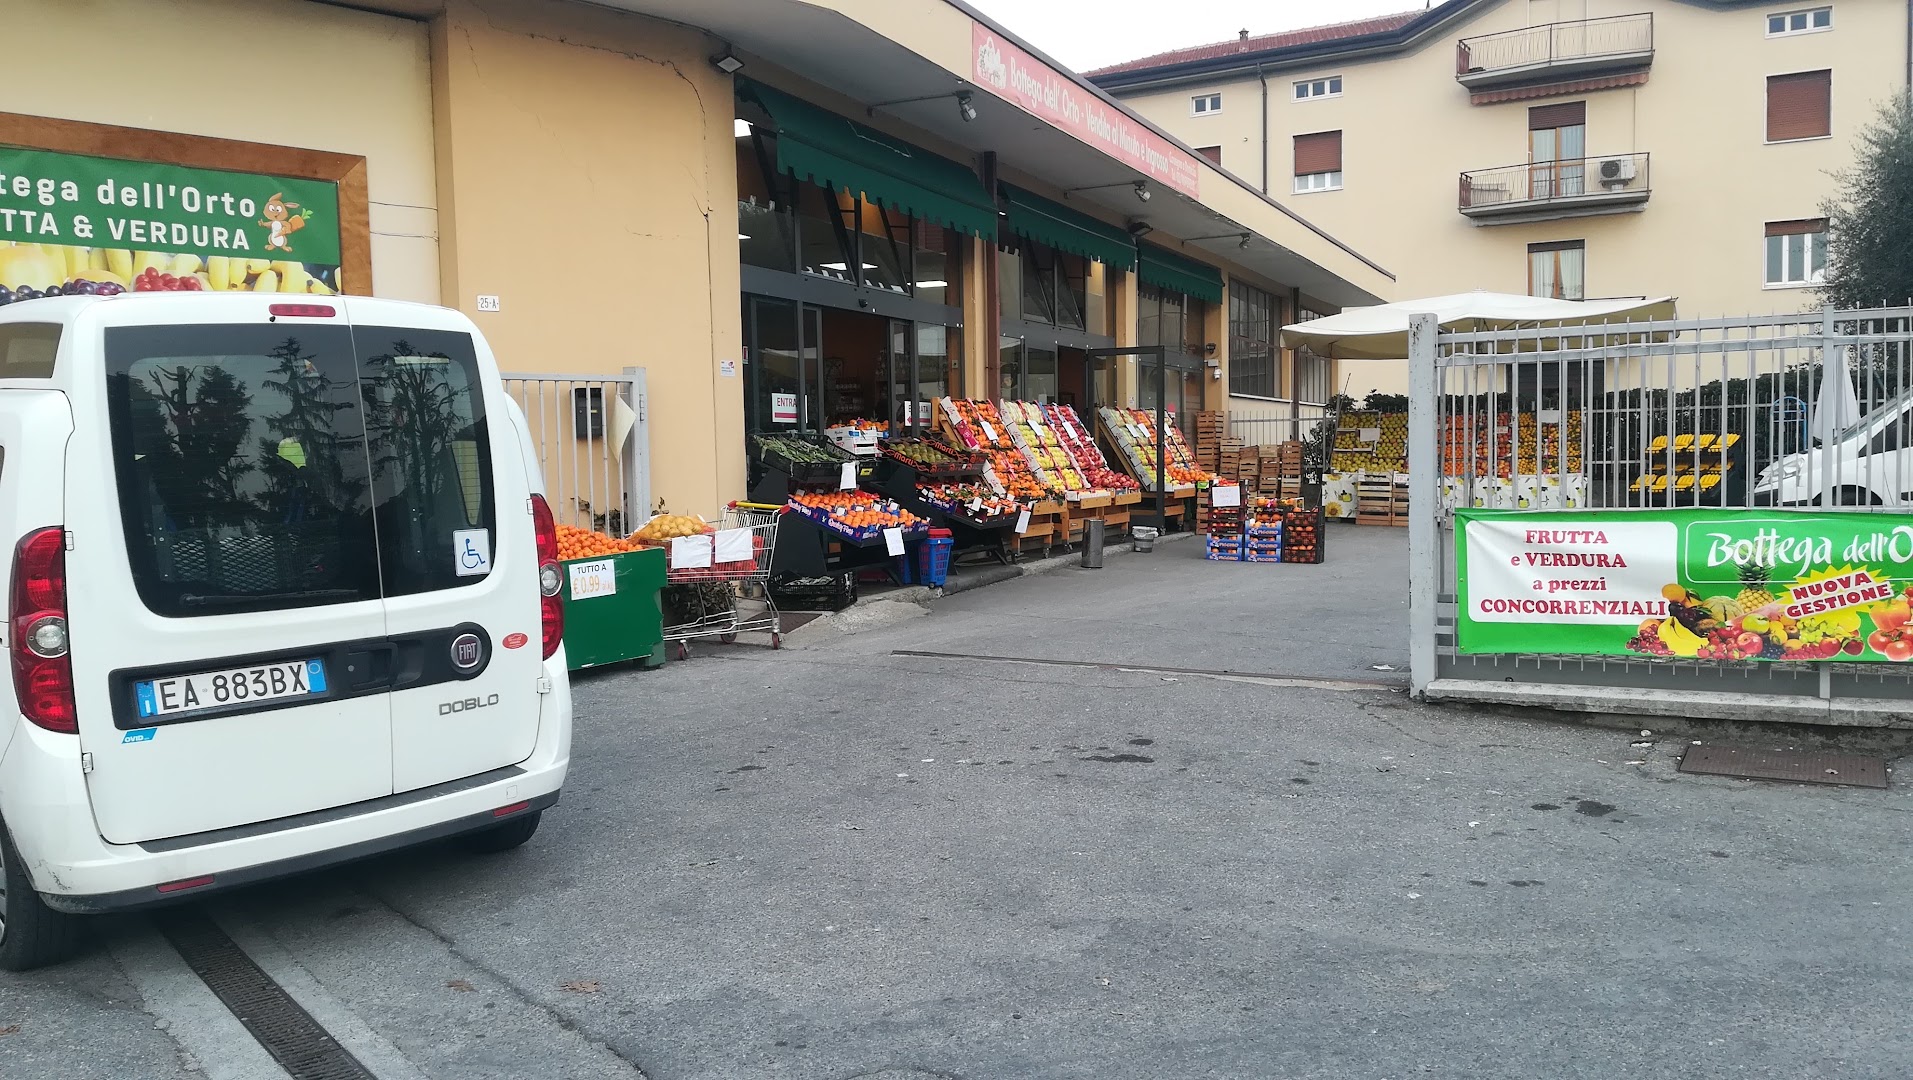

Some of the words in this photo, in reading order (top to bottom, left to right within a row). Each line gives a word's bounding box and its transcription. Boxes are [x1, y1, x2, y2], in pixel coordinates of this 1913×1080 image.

[1010, 56, 1042, 109] Bottega
[1062, 88, 1080, 125] Orto
[1085, 102, 1111, 141] Vendita
[1119, 122, 1140, 158] Minuto
[1145, 138, 1169, 174] Ingrosso
[97, 178, 256, 218] dell'Orto
[73, 214, 94, 239] &
[107, 217, 250, 250] VERDURA
[776, 397, 798, 408] ENTRA
[1525, 529, 1609, 544] FRUTTA
[1510, 555, 1521, 567] e
[1524, 552, 1628, 568] VERDURA
[1706, 527, 1833, 579] Bottega
[577, 564, 600, 575] TUTTO
[601, 563, 607, 571] A
[1532, 579, 1543, 590] a
[1548, 577, 1607, 593] prezzi
[1792, 572, 1872, 601] NUOVA
[1480, 598, 1667, 616] CONCORRENZIALI
[1786, 583, 1891, 618] GESTIONE
[459, 643, 477, 660] FIAT
[159, 678, 201, 711] EA
[211, 664, 307, 703] 883BX
[438, 693, 500, 716] DOBLO
